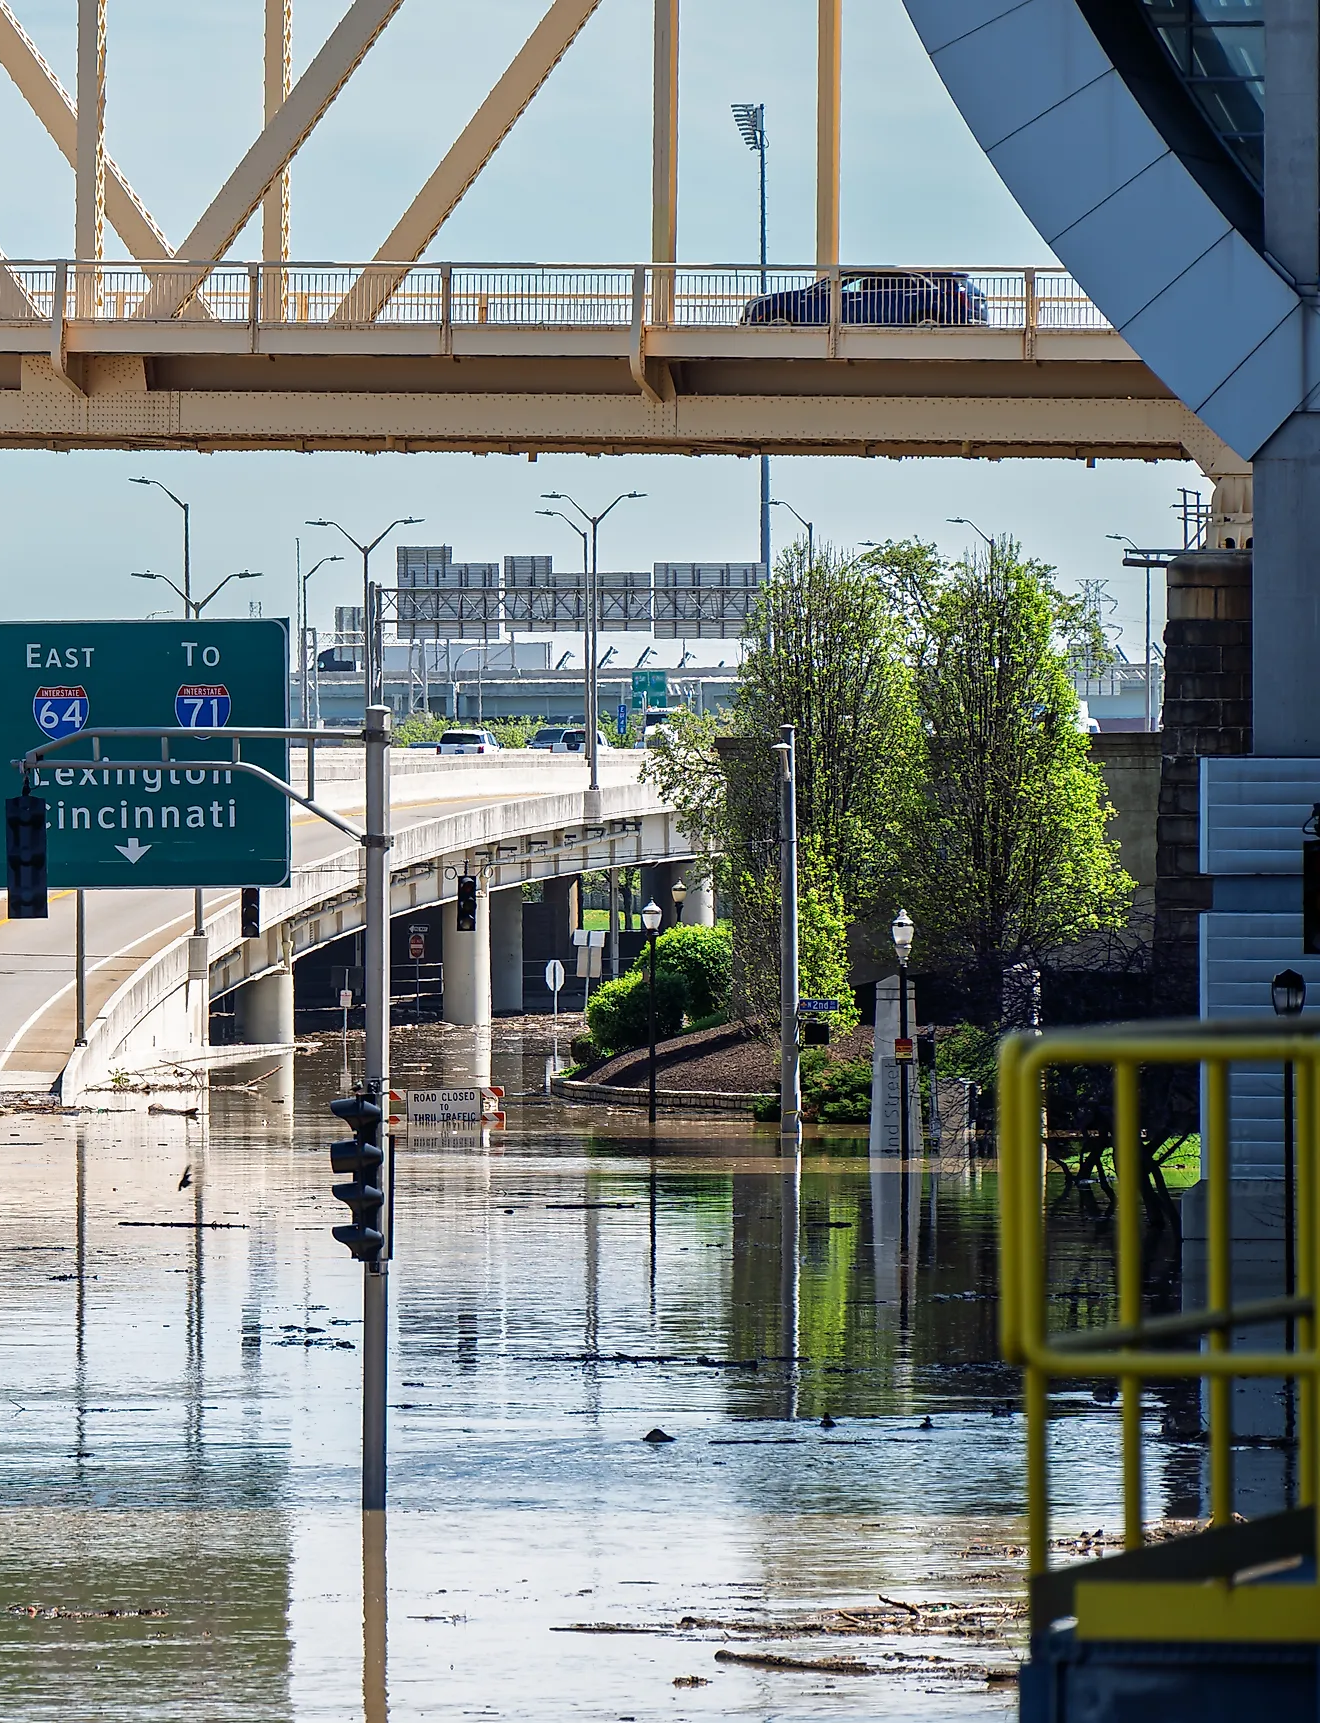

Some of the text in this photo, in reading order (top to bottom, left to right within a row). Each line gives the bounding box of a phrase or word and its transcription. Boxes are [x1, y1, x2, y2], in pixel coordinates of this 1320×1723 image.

[26, 643, 95, 668] EAST
[41, 689, 80, 697] INTERSTATE
[183, 687, 222, 696] INTERSTATE
[39, 699, 83, 729] 64
[183, 698, 218, 727] 71
[45, 798, 236, 829] incinnati
[812, 1000, 829, 1010] 2nd
[884, 1063, 900, 1118] Street
[413, 1091, 475, 1103] ROAD CLOSED
[439, 1103, 449, 1111] TO
[413, 1112, 476, 1121] THRU TRAFFIC
